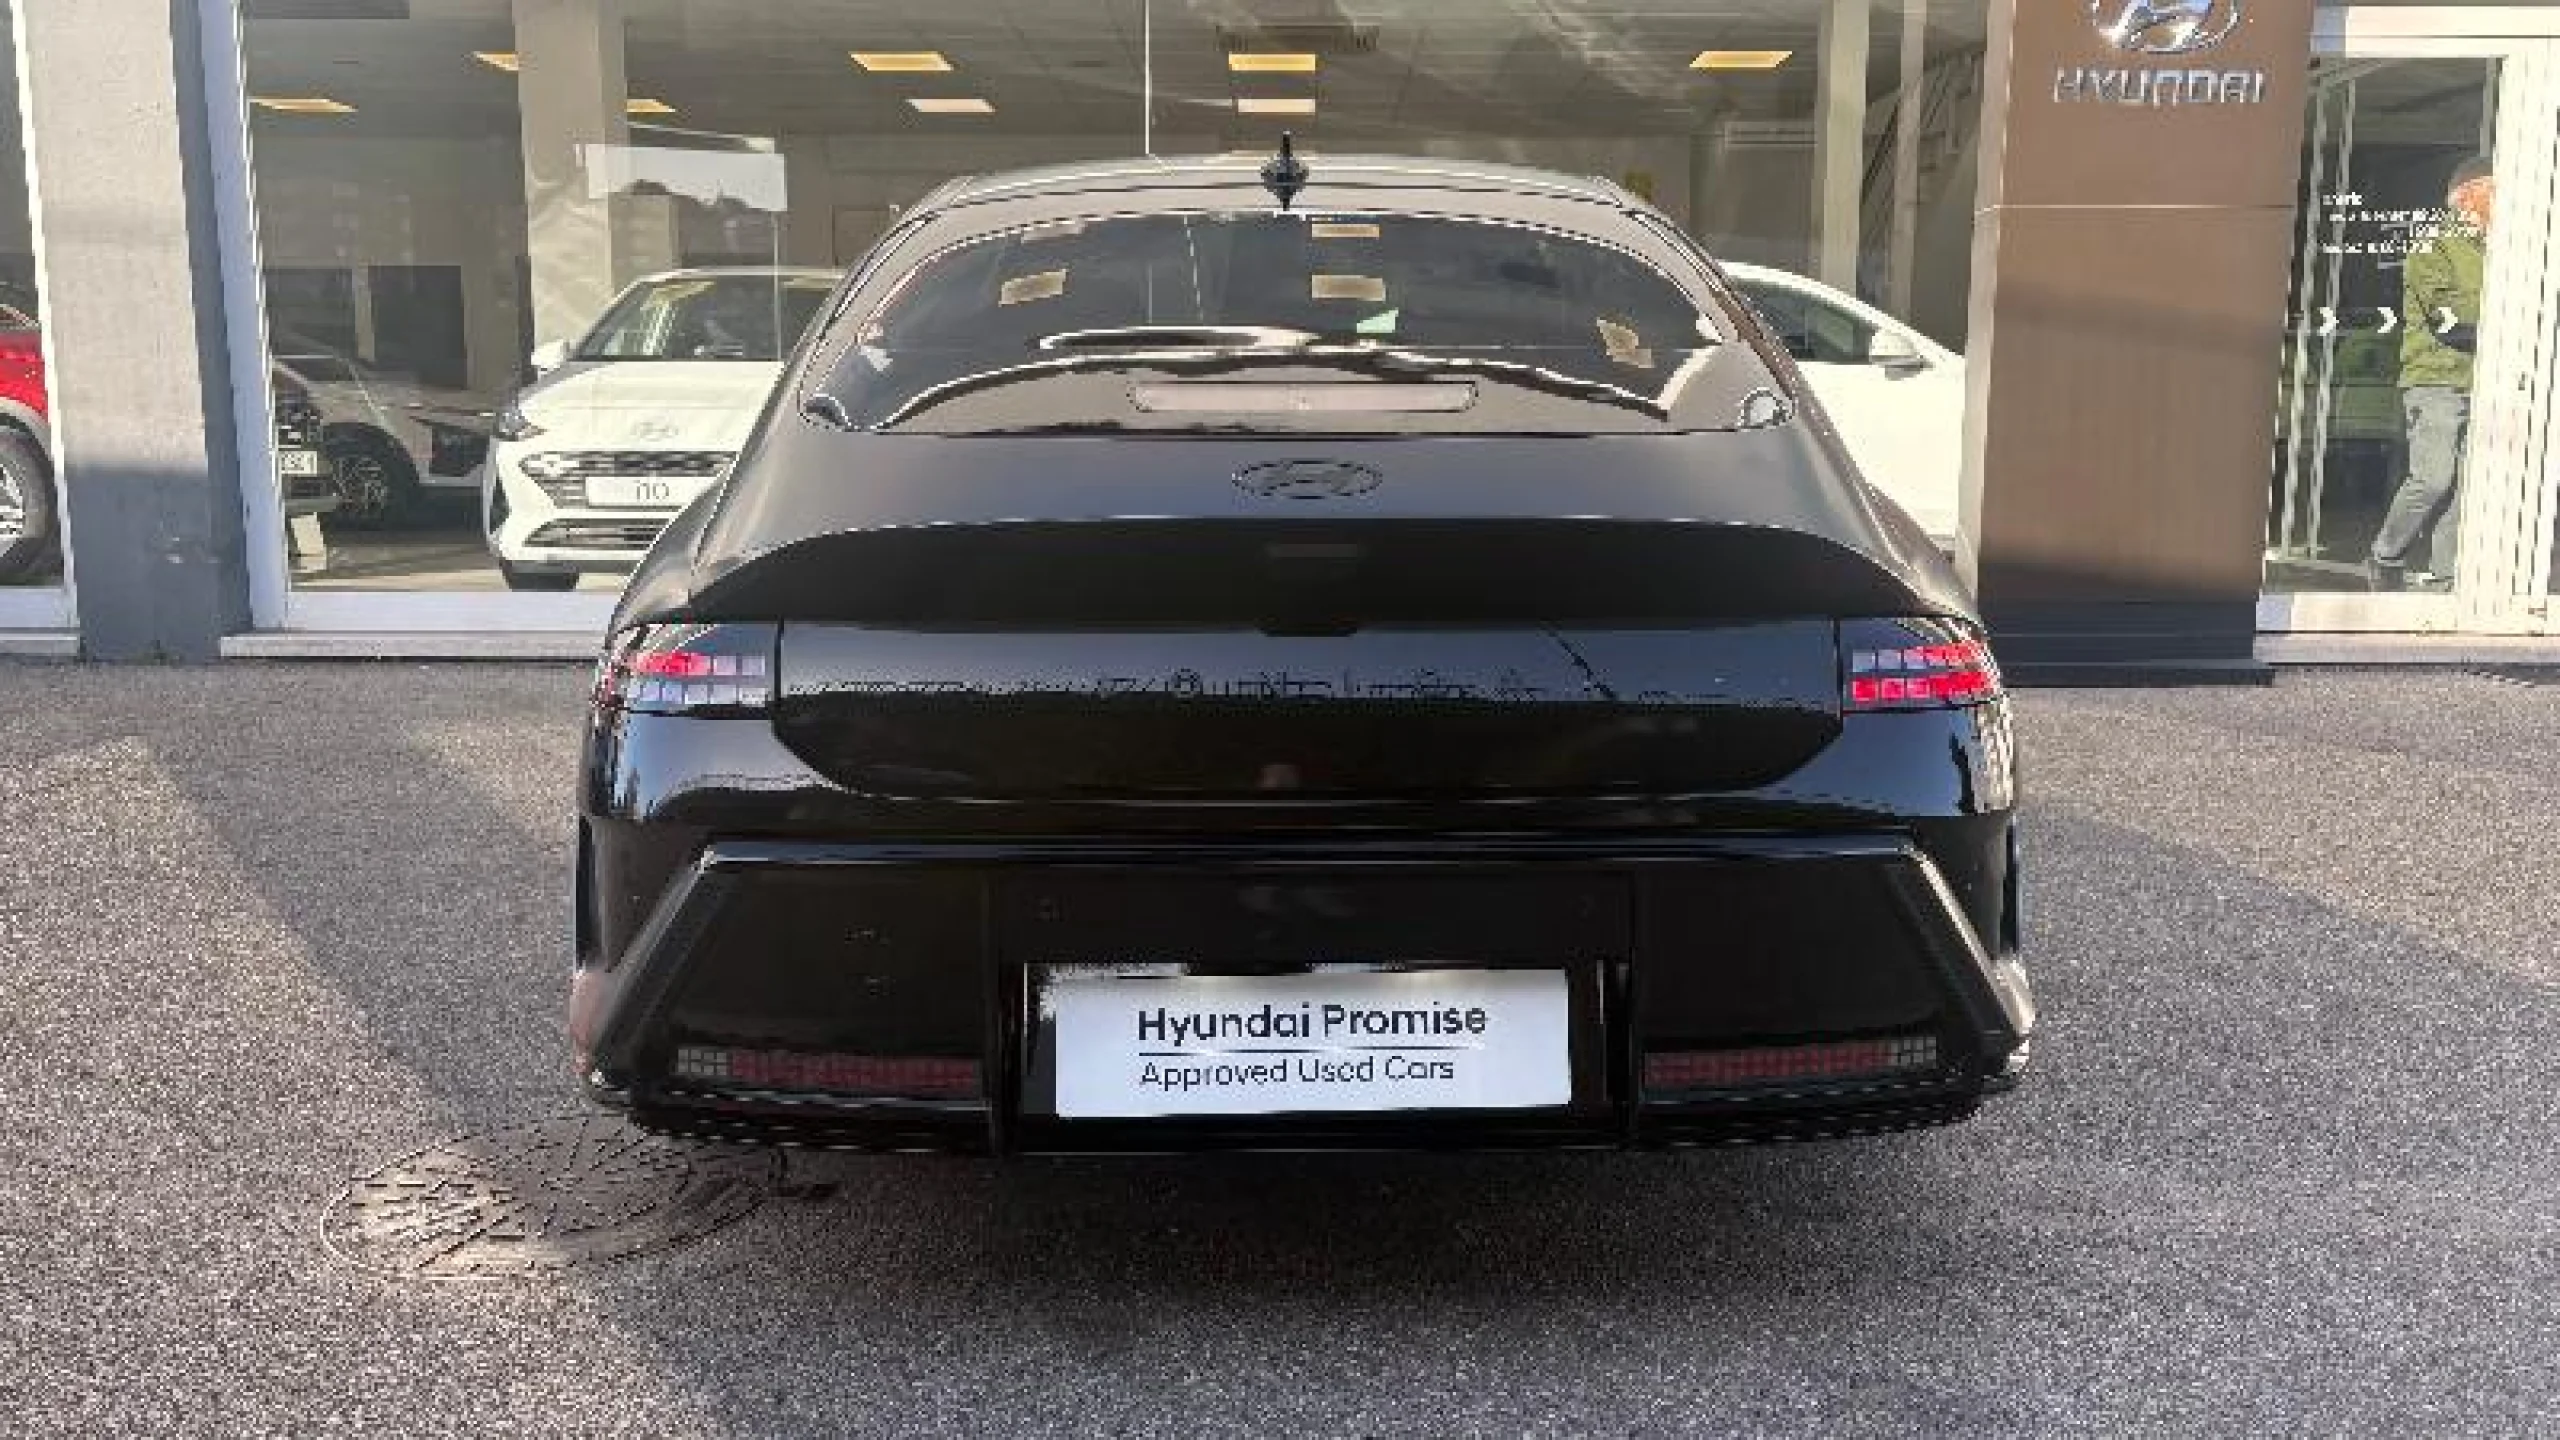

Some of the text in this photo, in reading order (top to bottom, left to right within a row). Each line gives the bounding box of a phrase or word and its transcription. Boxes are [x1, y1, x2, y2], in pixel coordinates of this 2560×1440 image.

[2053, 67, 2264, 105] HYUNDAI
[1138, 1001, 1487, 1047] Hyundai Promise
[1139, 1056, 1454, 1092] Approved Used Cars
